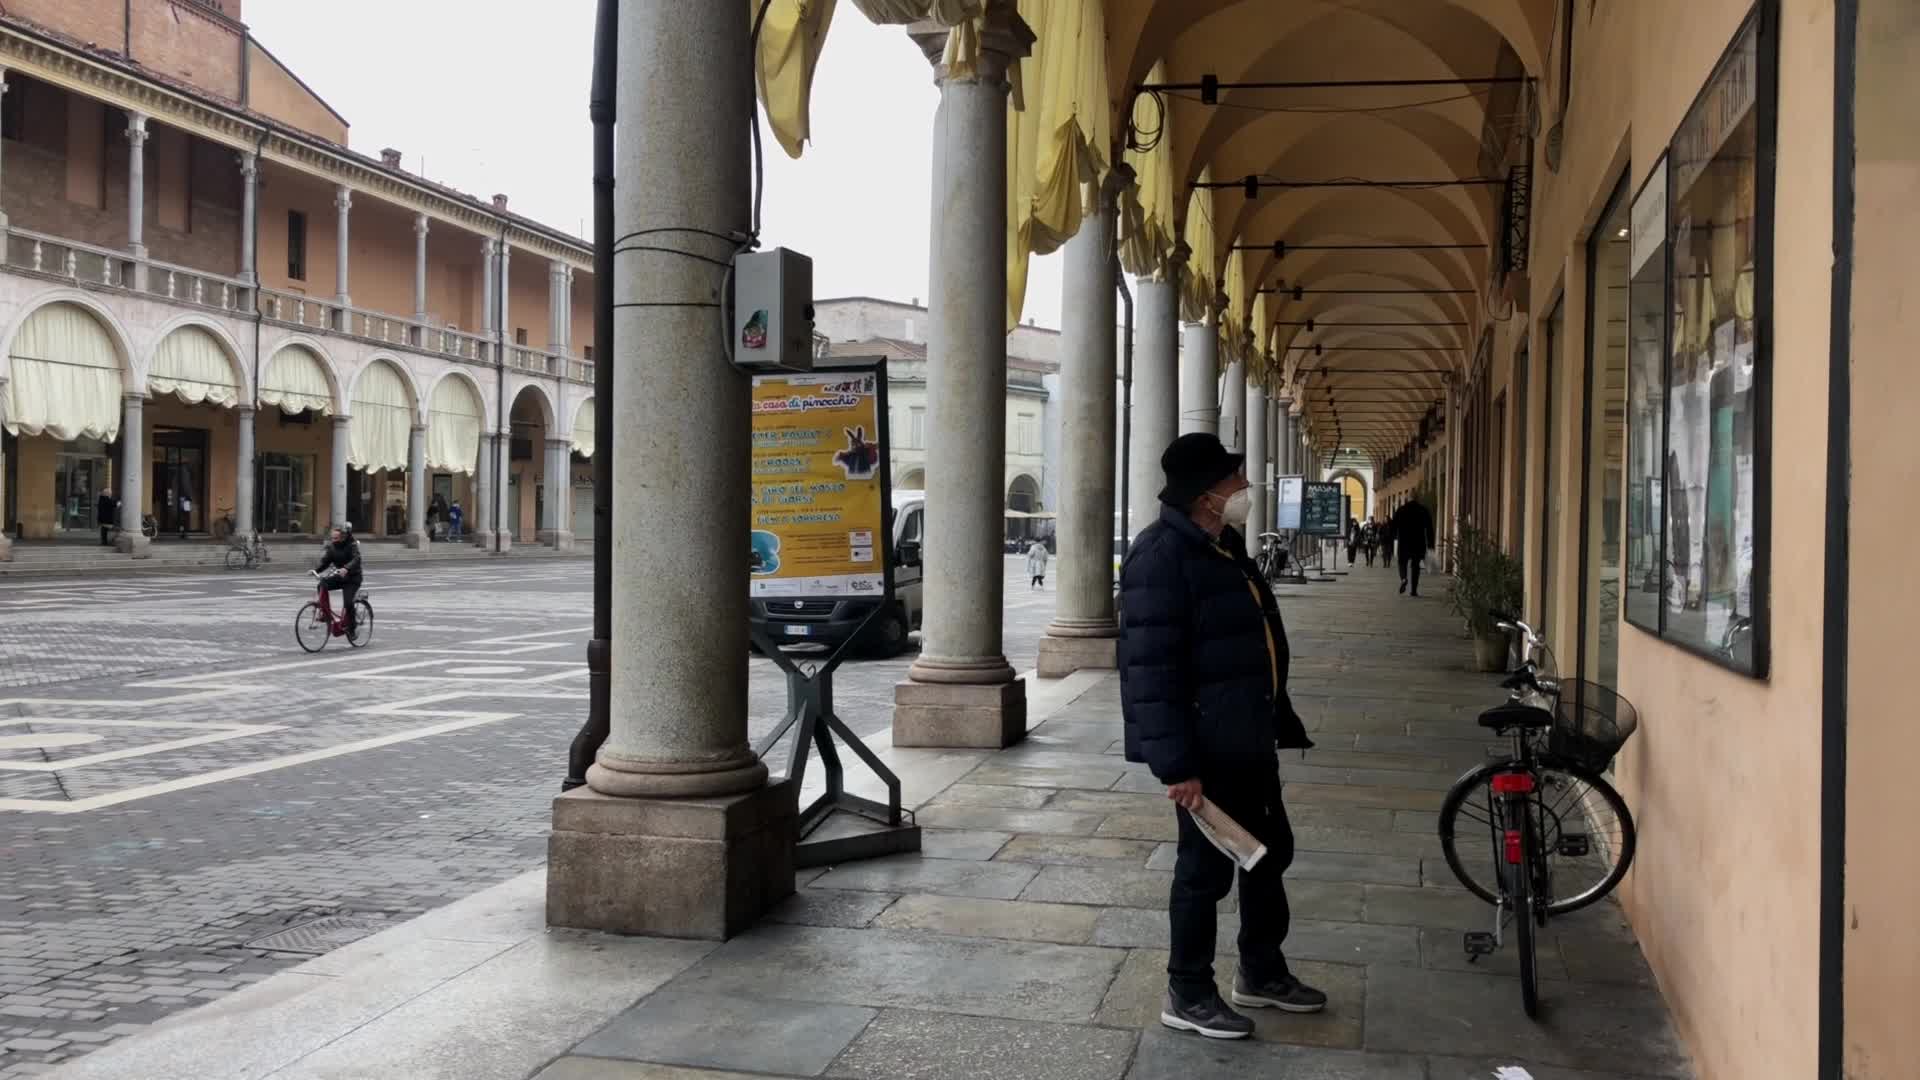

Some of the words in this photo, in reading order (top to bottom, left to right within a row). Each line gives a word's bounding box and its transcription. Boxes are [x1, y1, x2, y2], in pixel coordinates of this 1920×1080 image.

[763, 401, 788, 410] casa
[789, 398, 800, 409] di
[802, 395, 858, 411] pinocchio
